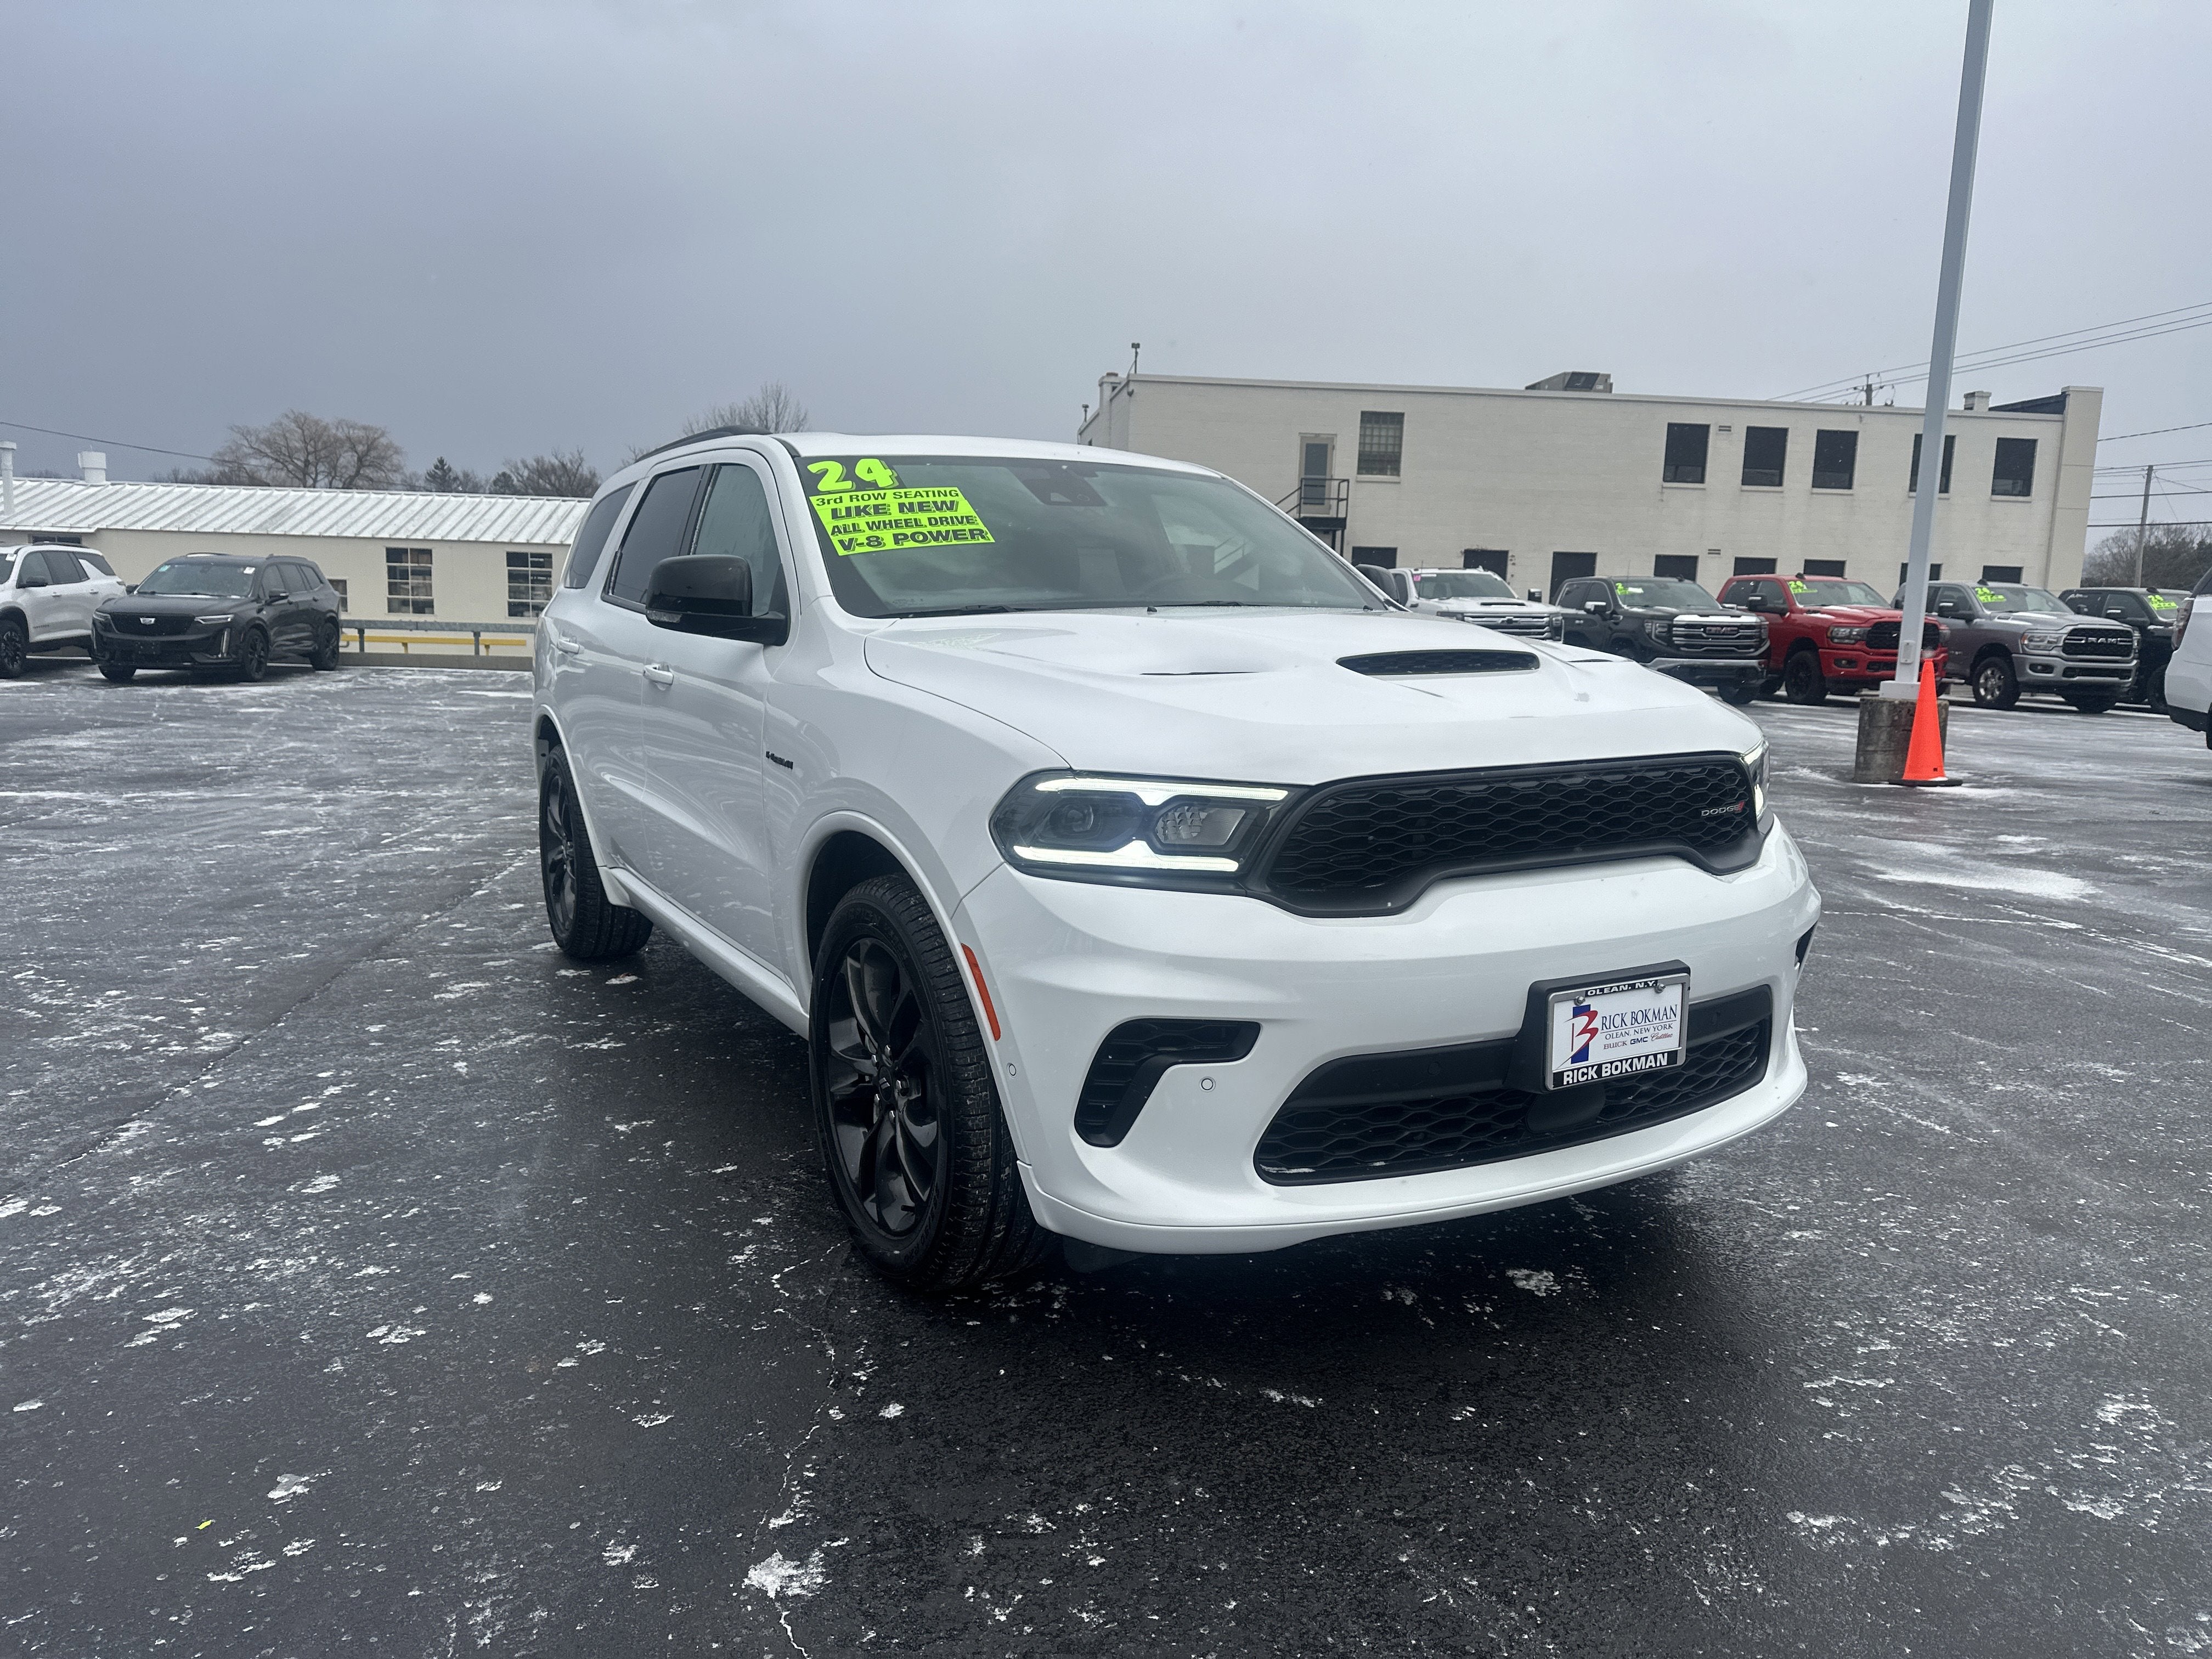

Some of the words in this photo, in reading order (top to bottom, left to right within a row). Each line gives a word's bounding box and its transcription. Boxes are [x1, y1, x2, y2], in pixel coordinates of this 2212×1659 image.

[807, 458, 898, 492] 24
[816, 496, 843, 506] 3rd
[849, 492, 887, 503] ROW
[893, 489, 959, 499] SEATING
[831, 503, 891, 520] LIKE
[898, 500, 958, 514] NEW
[831, 523, 865, 536] ALL
[865, 518, 927, 532] WHEEL
[927, 515, 979, 527] DRIVE
[838, 535, 886, 551] V-8
[893, 528, 991, 546] POWER
[1701, 803, 1741, 816] DODGE
[1635, 980, 1656, 989] N.Y.
[1601, 1012, 1628, 1031] RICK
[1630, 1005, 1678, 1026] BOKMAN
[1634, 1026, 1652, 1035] NEW
[1652, 1023, 1673, 1032] YORK
[1603, 1040, 1628, 1049] BUICK
[1630, 1036, 1648, 1045] GMC
[1564, 1065, 1598, 1085] RICK
[1602, 1053, 1668, 1077] BOKMAN
